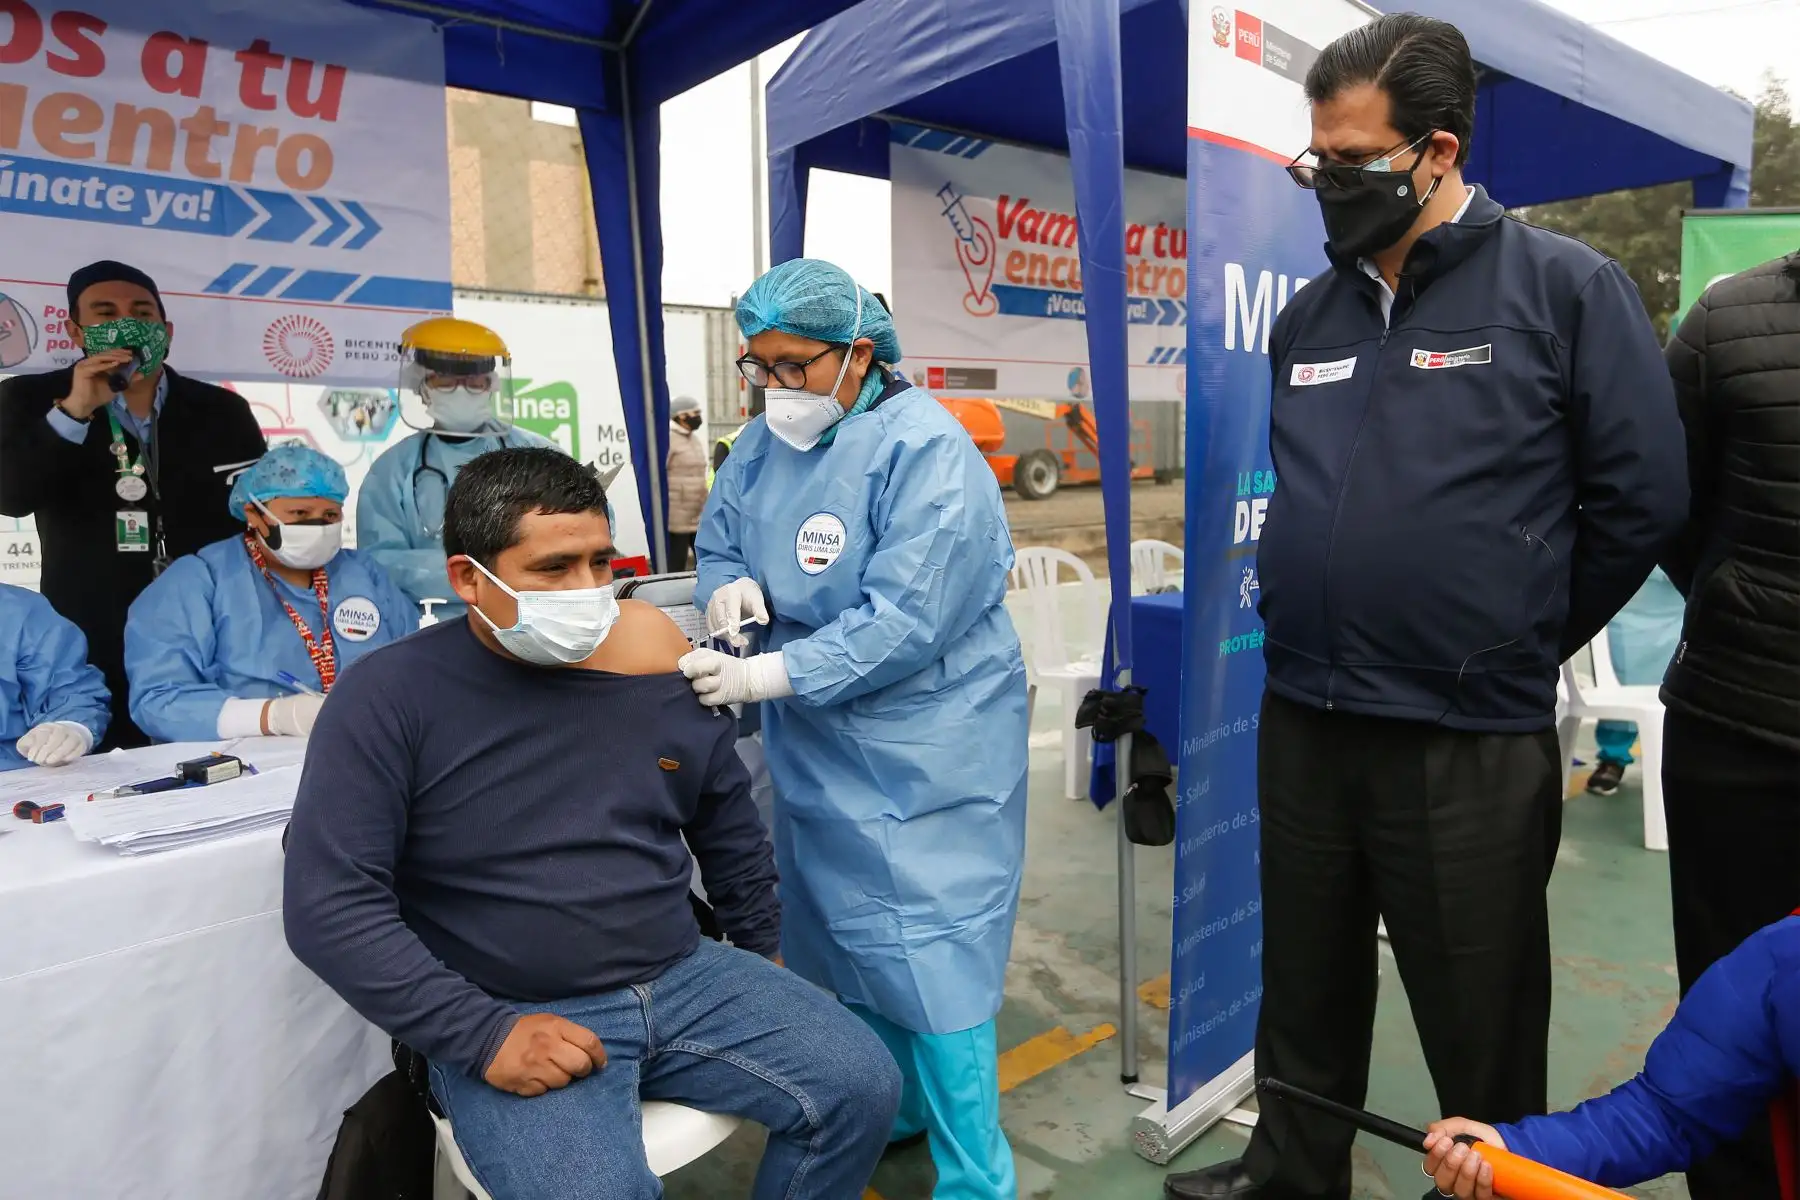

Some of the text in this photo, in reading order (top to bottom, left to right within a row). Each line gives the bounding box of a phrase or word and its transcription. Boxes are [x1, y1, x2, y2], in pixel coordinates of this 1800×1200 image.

[1238, 27, 1260, 47] PERÚ
[141, 31, 209, 98] a
[235, 39, 348, 122] tu
[141, 188, 216, 226] ya!
[996, 194, 1078, 248] Vam
[44, 305, 71, 320] Po
[345, 351, 379, 360] PERÚ
[599, 448, 624, 466] de
[1237, 470, 1278, 496] LA SA
[7, 542, 34, 557] 44
[802, 531, 840, 546] MINSA
[339, 608, 374, 621] MINSA
[1183, 722, 1230, 757] Ministerio
[1233, 717, 1248, 734] de
[1186, 775, 1210, 804] Salud
[1180, 819, 1230, 858] Ministerio
[1232, 812, 1247, 829] de
[1183, 872, 1206, 904] Salud
[1177, 916, 1229, 959] Ministerio
[1231, 907, 1246, 924] de
[1173, 1010, 1227, 1057] Ministerio
[1229, 998, 1242, 1017] de
